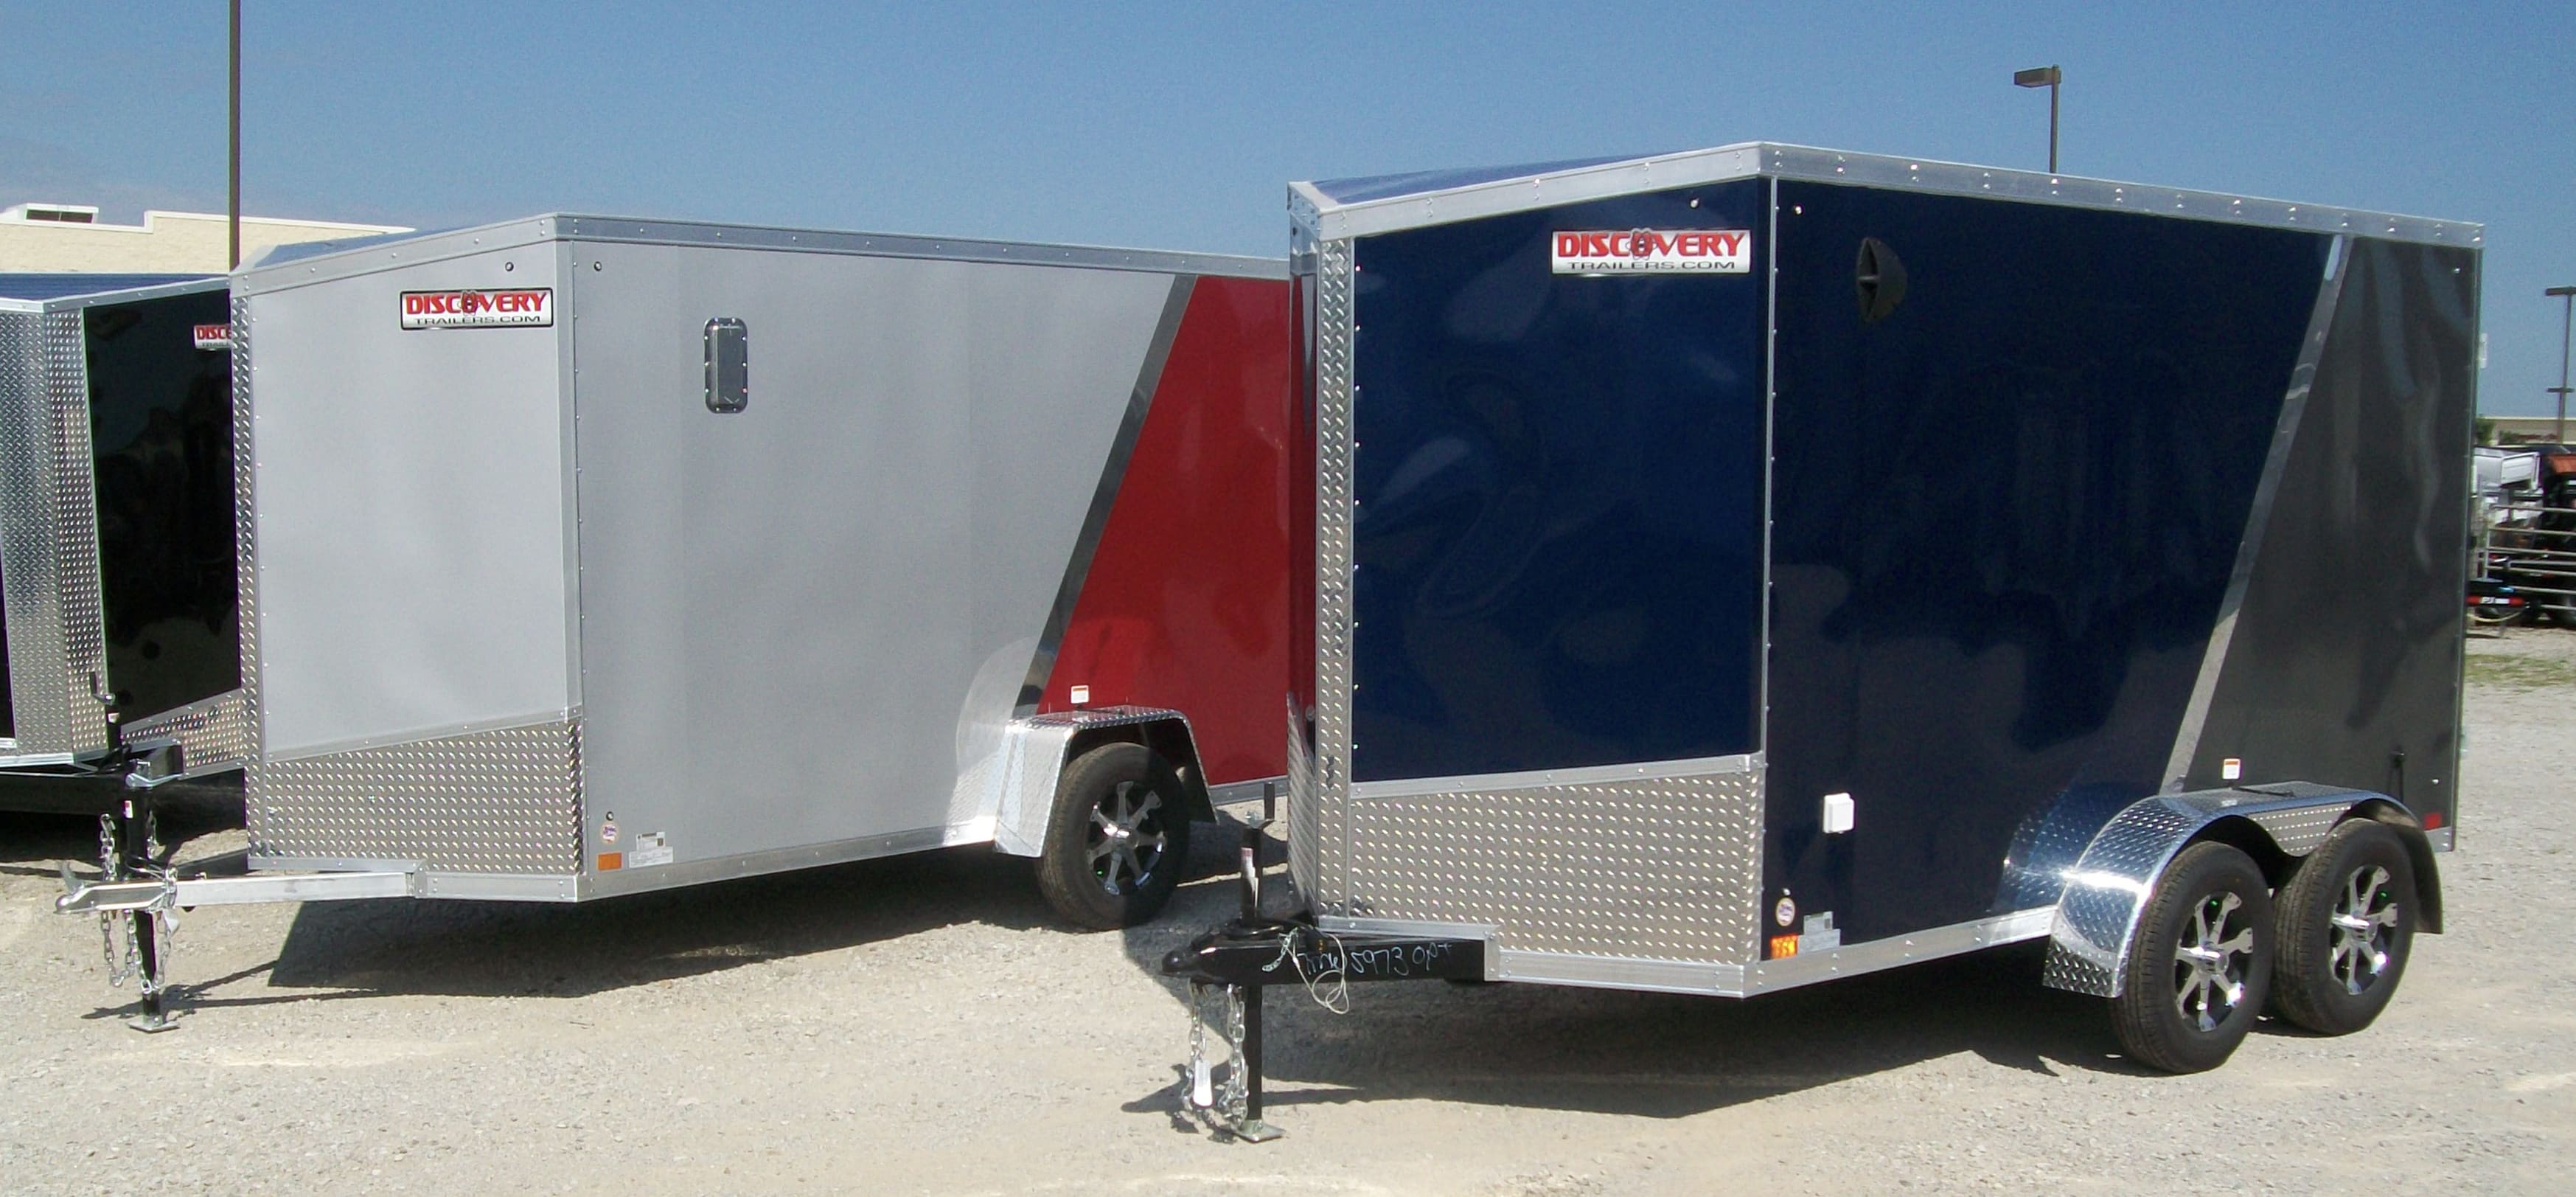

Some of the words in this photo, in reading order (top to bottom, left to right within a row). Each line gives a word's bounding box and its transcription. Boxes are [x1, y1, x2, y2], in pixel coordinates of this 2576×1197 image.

[1557, 232, 1744, 257] DISCOVERY
[1568, 260, 1735, 270] TRAILERS.COM
[406, 292, 547, 314] DISCOVERY
[414, 316, 540, 325] TRAILERS.COM
